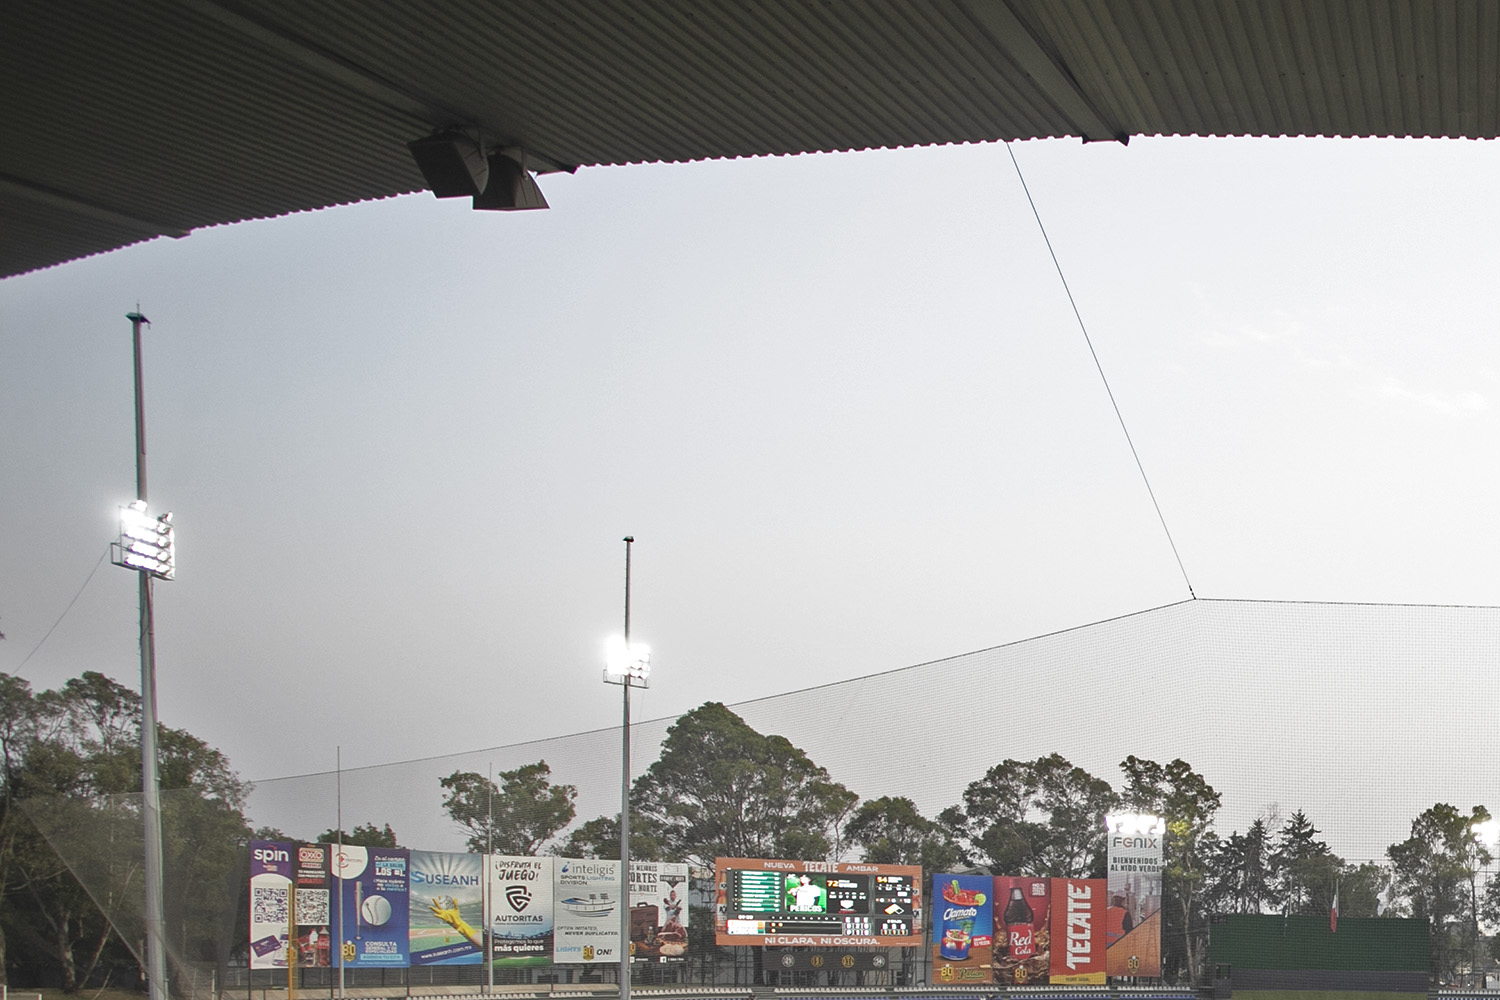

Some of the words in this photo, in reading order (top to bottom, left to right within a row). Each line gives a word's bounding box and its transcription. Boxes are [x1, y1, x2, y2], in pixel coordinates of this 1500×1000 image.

[254, 848, 289, 864] spin
[300, 850, 322, 860] OXXO
[572, 864, 615, 876] inteligis
[764, 862, 796, 870] NUEVA
[802, 862, 839, 872] TECATE
[410, 871, 479, 886] SUSEANH
[498, 870, 539, 882] JUEGO!
[629, 873, 658, 884] ORTES
[943, 906, 978, 921] Clamato
[1066, 883, 1092, 970] TECATE
[778, 937, 816, 946] CLARA,
[833, 938, 880, 946] OSCURA.
[1009, 930, 1032, 946] Red
[494, 944, 512, 952] más
[513, 944, 544, 953] quieres
[1014, 948, 1032, 956] Cola
[1128, 958, 1140, 968] 80
[941, 967, 952, 976] 80
[1015, 968, 1027, 978] 80
